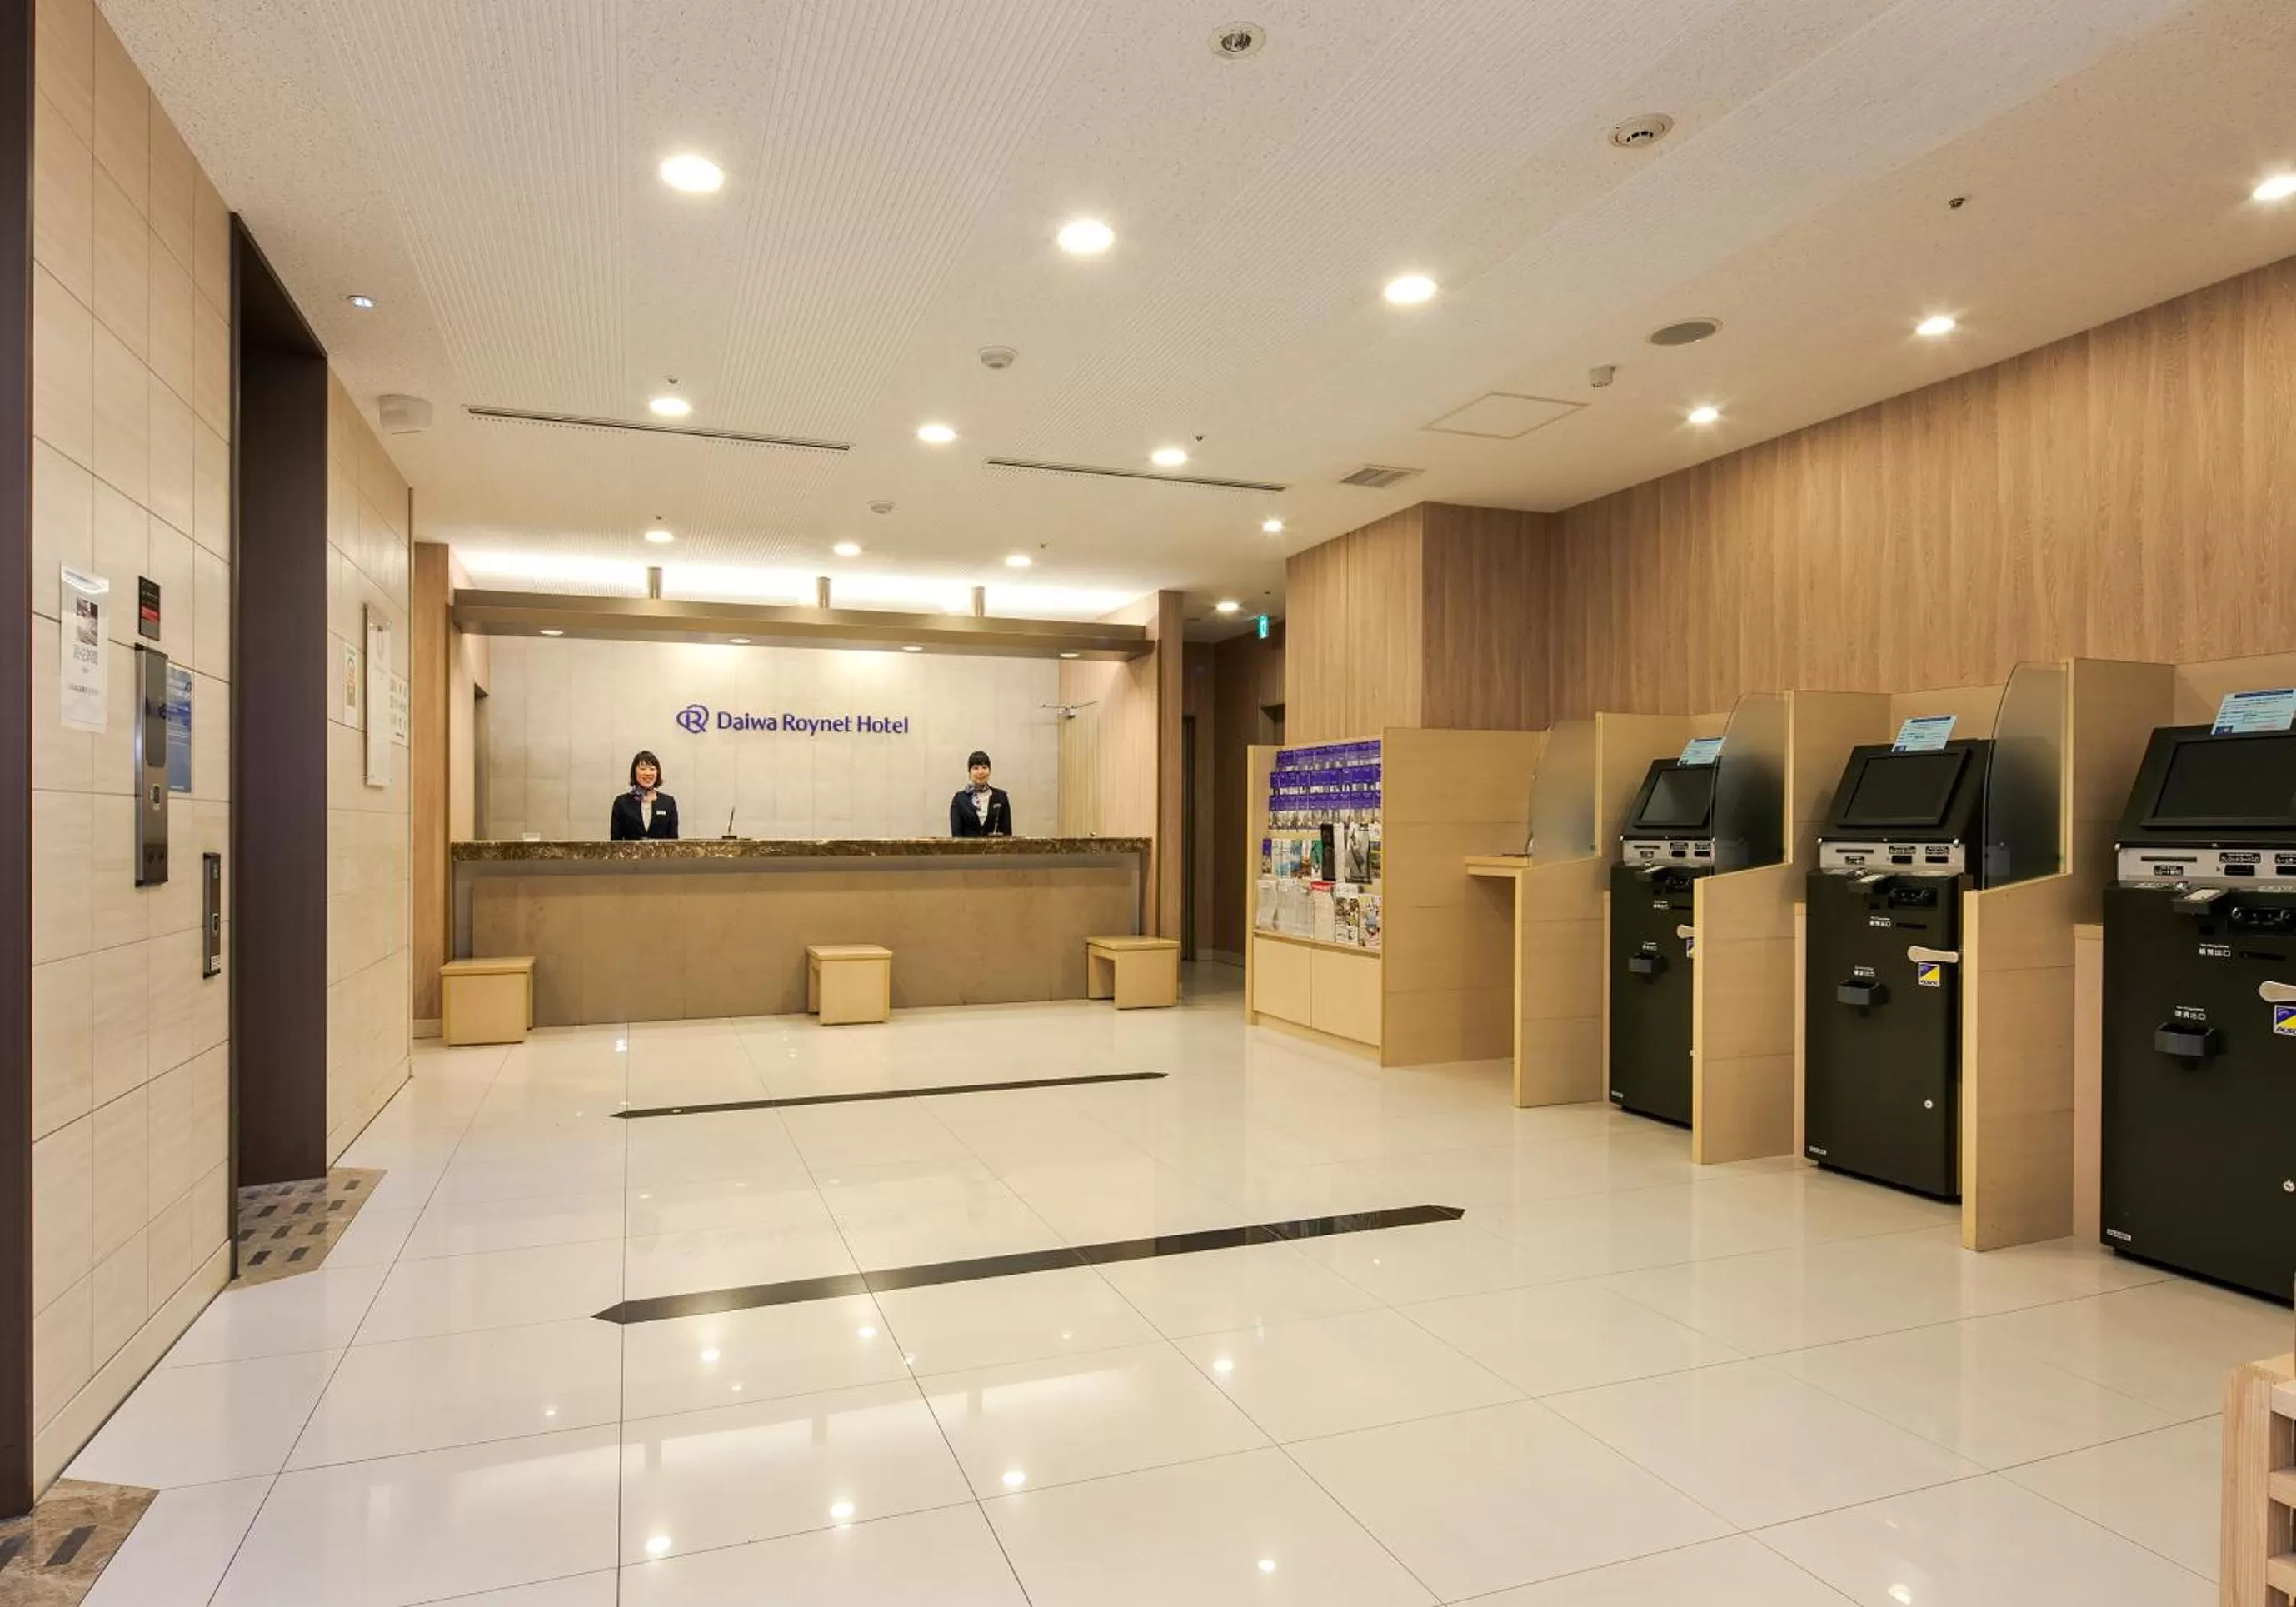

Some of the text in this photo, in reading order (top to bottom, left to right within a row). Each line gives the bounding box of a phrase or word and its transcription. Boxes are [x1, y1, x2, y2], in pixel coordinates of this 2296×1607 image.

[717, 711, 908, 736] Daiwa Roynet Hotel
